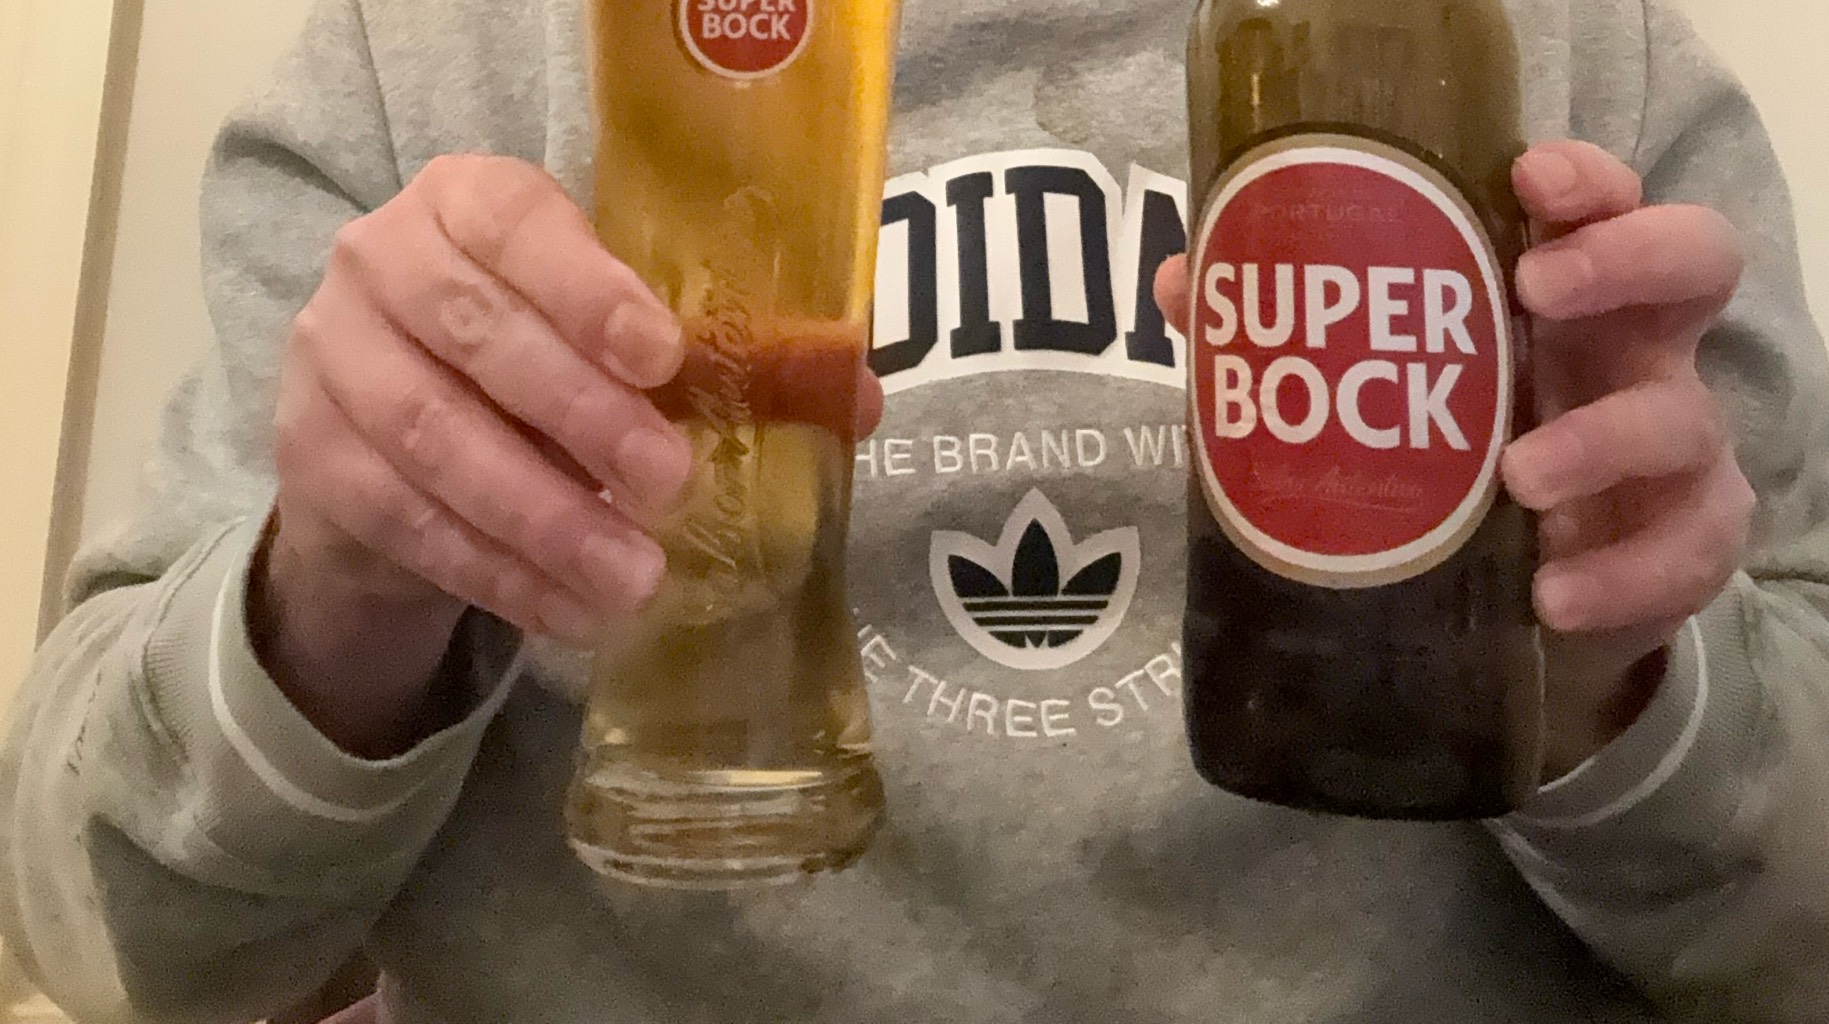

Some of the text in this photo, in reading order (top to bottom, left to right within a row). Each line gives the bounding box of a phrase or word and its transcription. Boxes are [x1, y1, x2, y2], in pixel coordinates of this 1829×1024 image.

[702, 12, 791, 40] BOCK
[1204, 261, 1478, 355] SUPER
[933, 428, 1107, 473] BRAND
[1125, 424, 1186, 468] WI
[1214, 355, 1471, 452] BOCK
[855, 612, 1182, 738] E THREE STR
